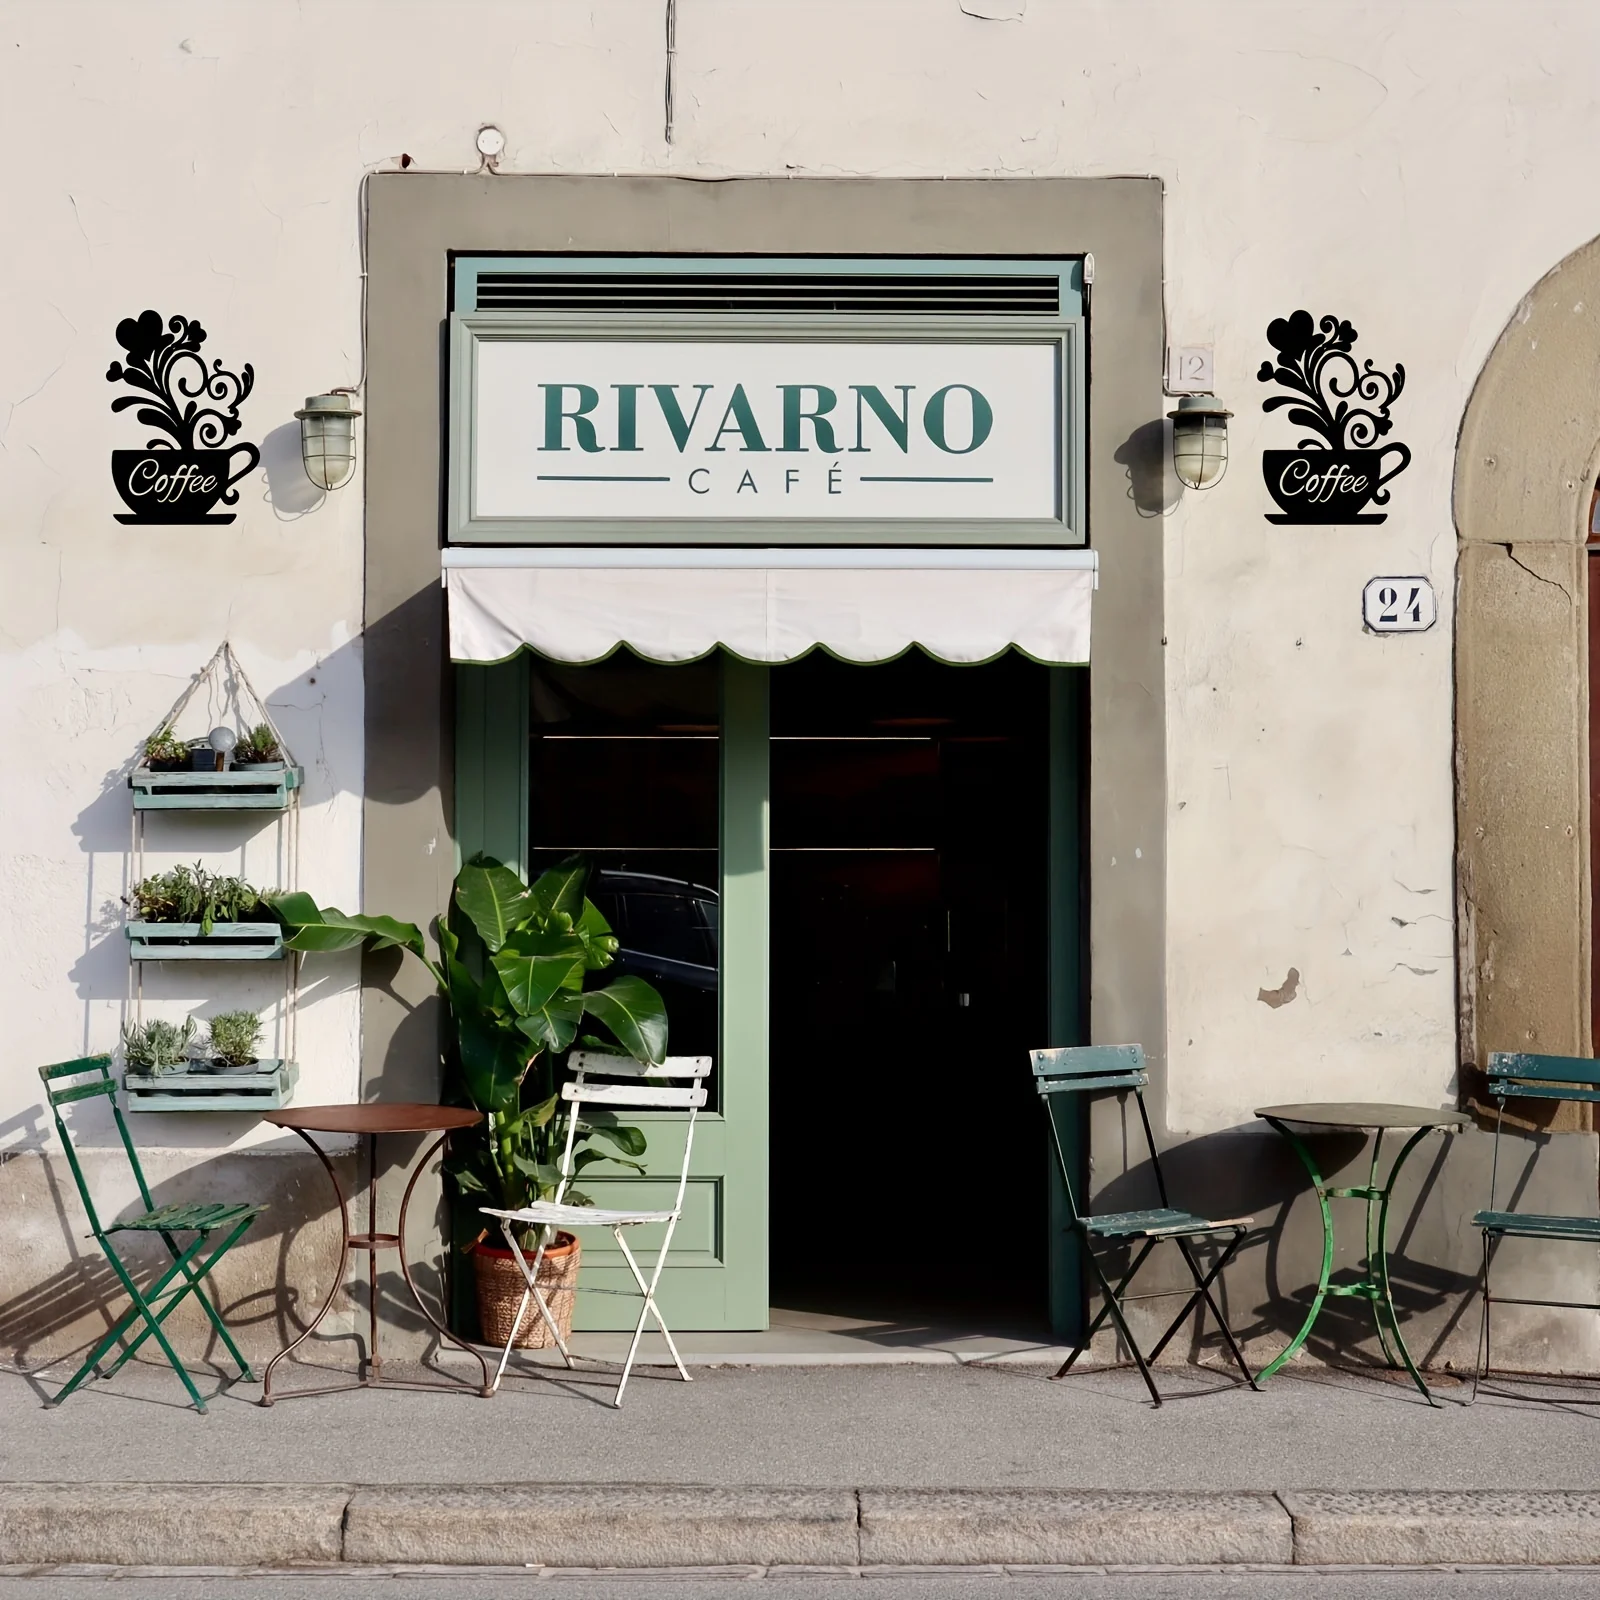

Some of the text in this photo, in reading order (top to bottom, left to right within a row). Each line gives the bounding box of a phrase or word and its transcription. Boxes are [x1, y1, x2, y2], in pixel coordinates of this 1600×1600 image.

[1179, 356, 1205, 381] 12
[537, 383, 993, 455] RIVARNO
[128, 458, 218, 503] Coffee
[688, 462, 842, 495] CAFÉ
[1279, 458, 1369, 503] Coffee
[1378, 587, 1422, 623] 24
